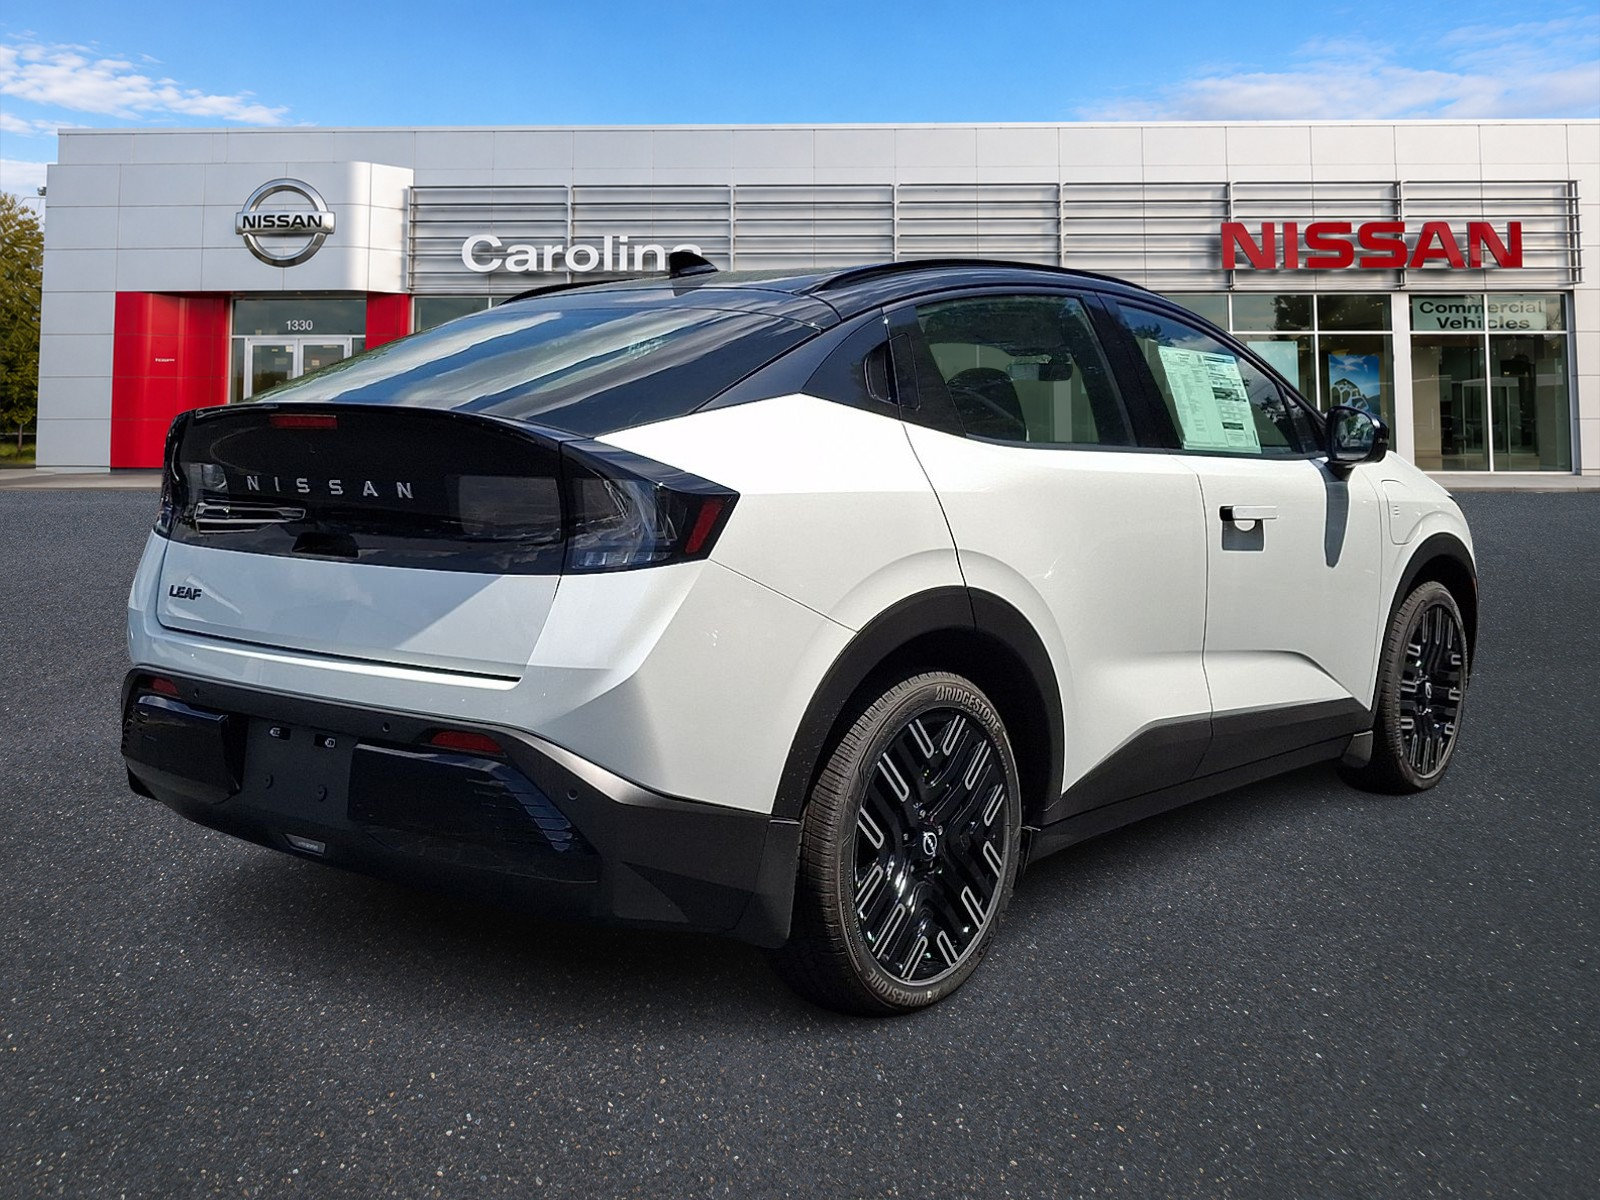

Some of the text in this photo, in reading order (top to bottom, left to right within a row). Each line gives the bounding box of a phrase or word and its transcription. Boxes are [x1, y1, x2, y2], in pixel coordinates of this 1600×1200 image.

[242, 214, 323, 229] NISSAN
[1220, 221, 1523, 269] NISSAN
[1419, 301, 1543, 314] Commercial
[286, 320, 314, 331] 1330
[1436, 316, 1530, 329] Vehicles
[246, 475, 414, 499] NISSAN
[168, 584, 203, 601] LEAF
[935, 685, 1001, 734] BRIDGESTONE
